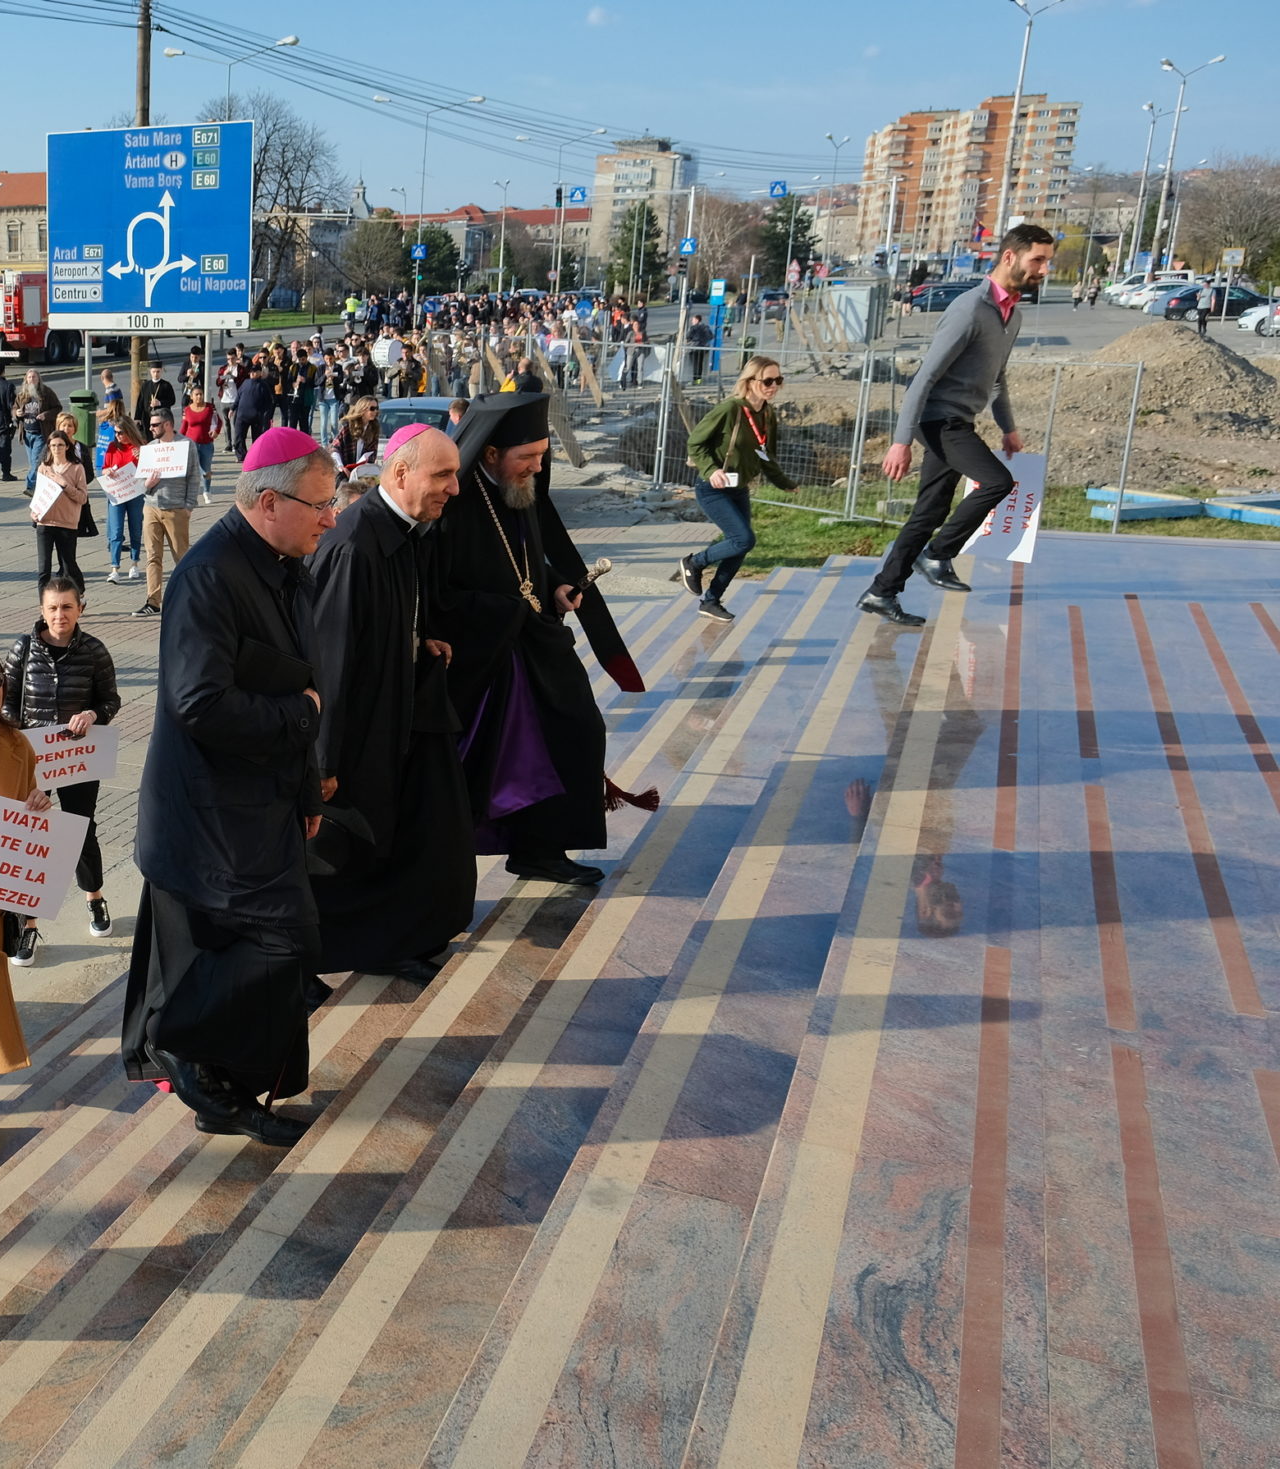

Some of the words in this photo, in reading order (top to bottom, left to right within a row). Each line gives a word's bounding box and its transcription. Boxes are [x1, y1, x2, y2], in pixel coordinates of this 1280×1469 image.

[124, 133, 149, 148] Satu
[153, 131, 182, 146] Mare
[194, 131, 217, 144] E671
[125, 152, 160, 169] Ártánd
[169, 153, 178, 167] H
[124, 174, 154, 189] Vama
[53, 246, 77, 260] Arad
[84, 247, 101, 257] E671
[54, 265, 88, 278] Aeroport
[54, 287, 87, 300] Centru
[180, 277, 201, 294] Cluj
[205, 276, 246, 294] Napoca
[127, 314, 149, 328] 100
[153, 317, 164, 328] m
[1001, 516, 1014, 534] UN
[35, 744, 96, 764] PENTRU
[42, 761, 87, 780] VIAȚĂ
[2, 808, 49, 833] VIAȚA
[25, 842, 50, 859] UN
[24, 868, 46, 885] LA
